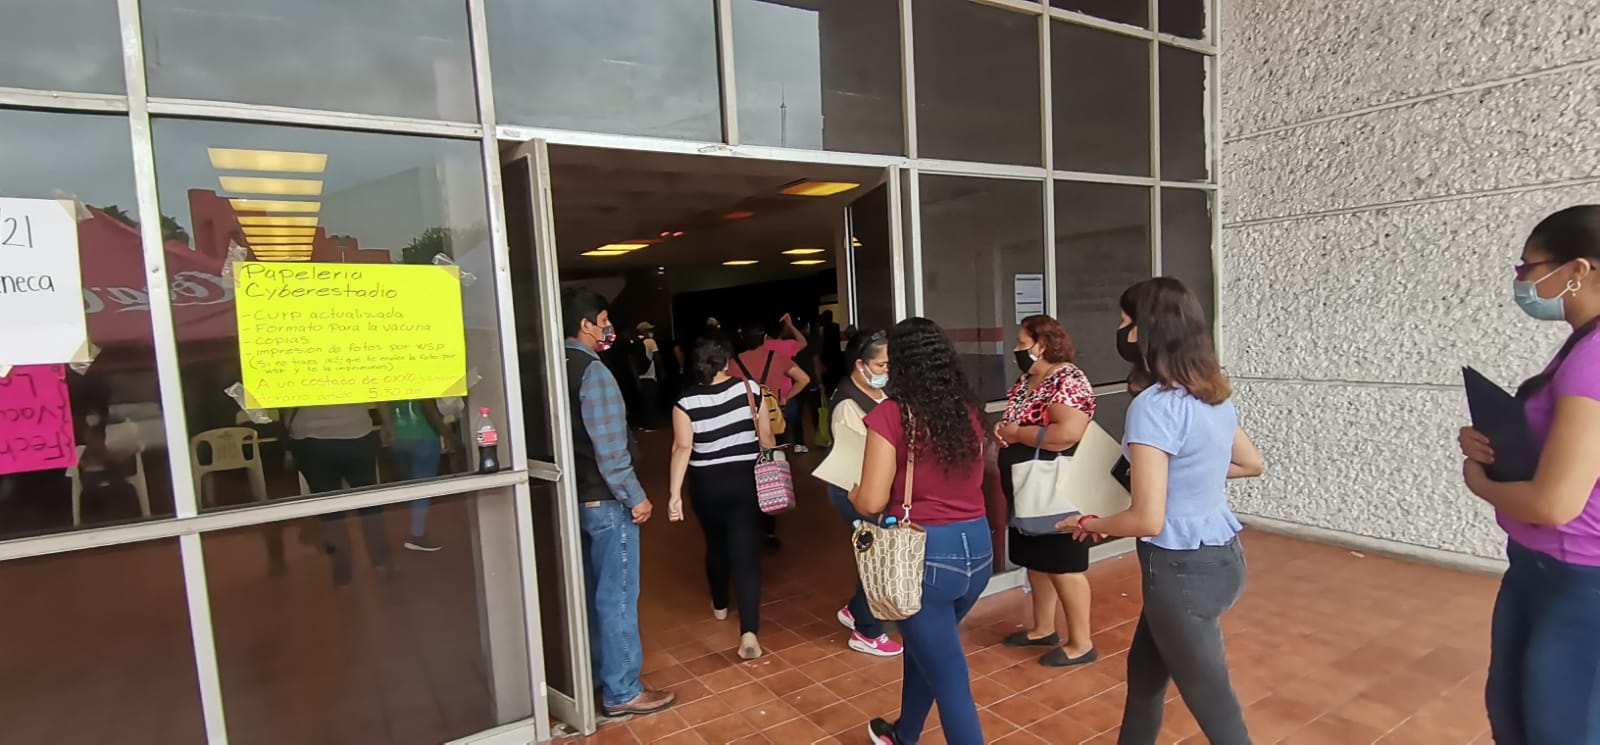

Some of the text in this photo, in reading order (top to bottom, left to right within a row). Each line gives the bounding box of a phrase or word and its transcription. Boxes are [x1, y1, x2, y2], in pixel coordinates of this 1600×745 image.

[241, 263, 364, 284] Papeleria
[245, 281, 398, 301] Cyberestadio
[310, 306, 404, 320] actualizada
[367, 321, 378, 331] la
[382, 323, 432, 332] vacuna
[328, 344, 343, 354] de
[348, 342, 383, 352] fotos
[390, 343, 408, 353] por
[256, 377, 269, 390] A
[278, 380, 295, 389] un
[300, 375, 355, 386] costado
[361, 375, 379, 385] de
